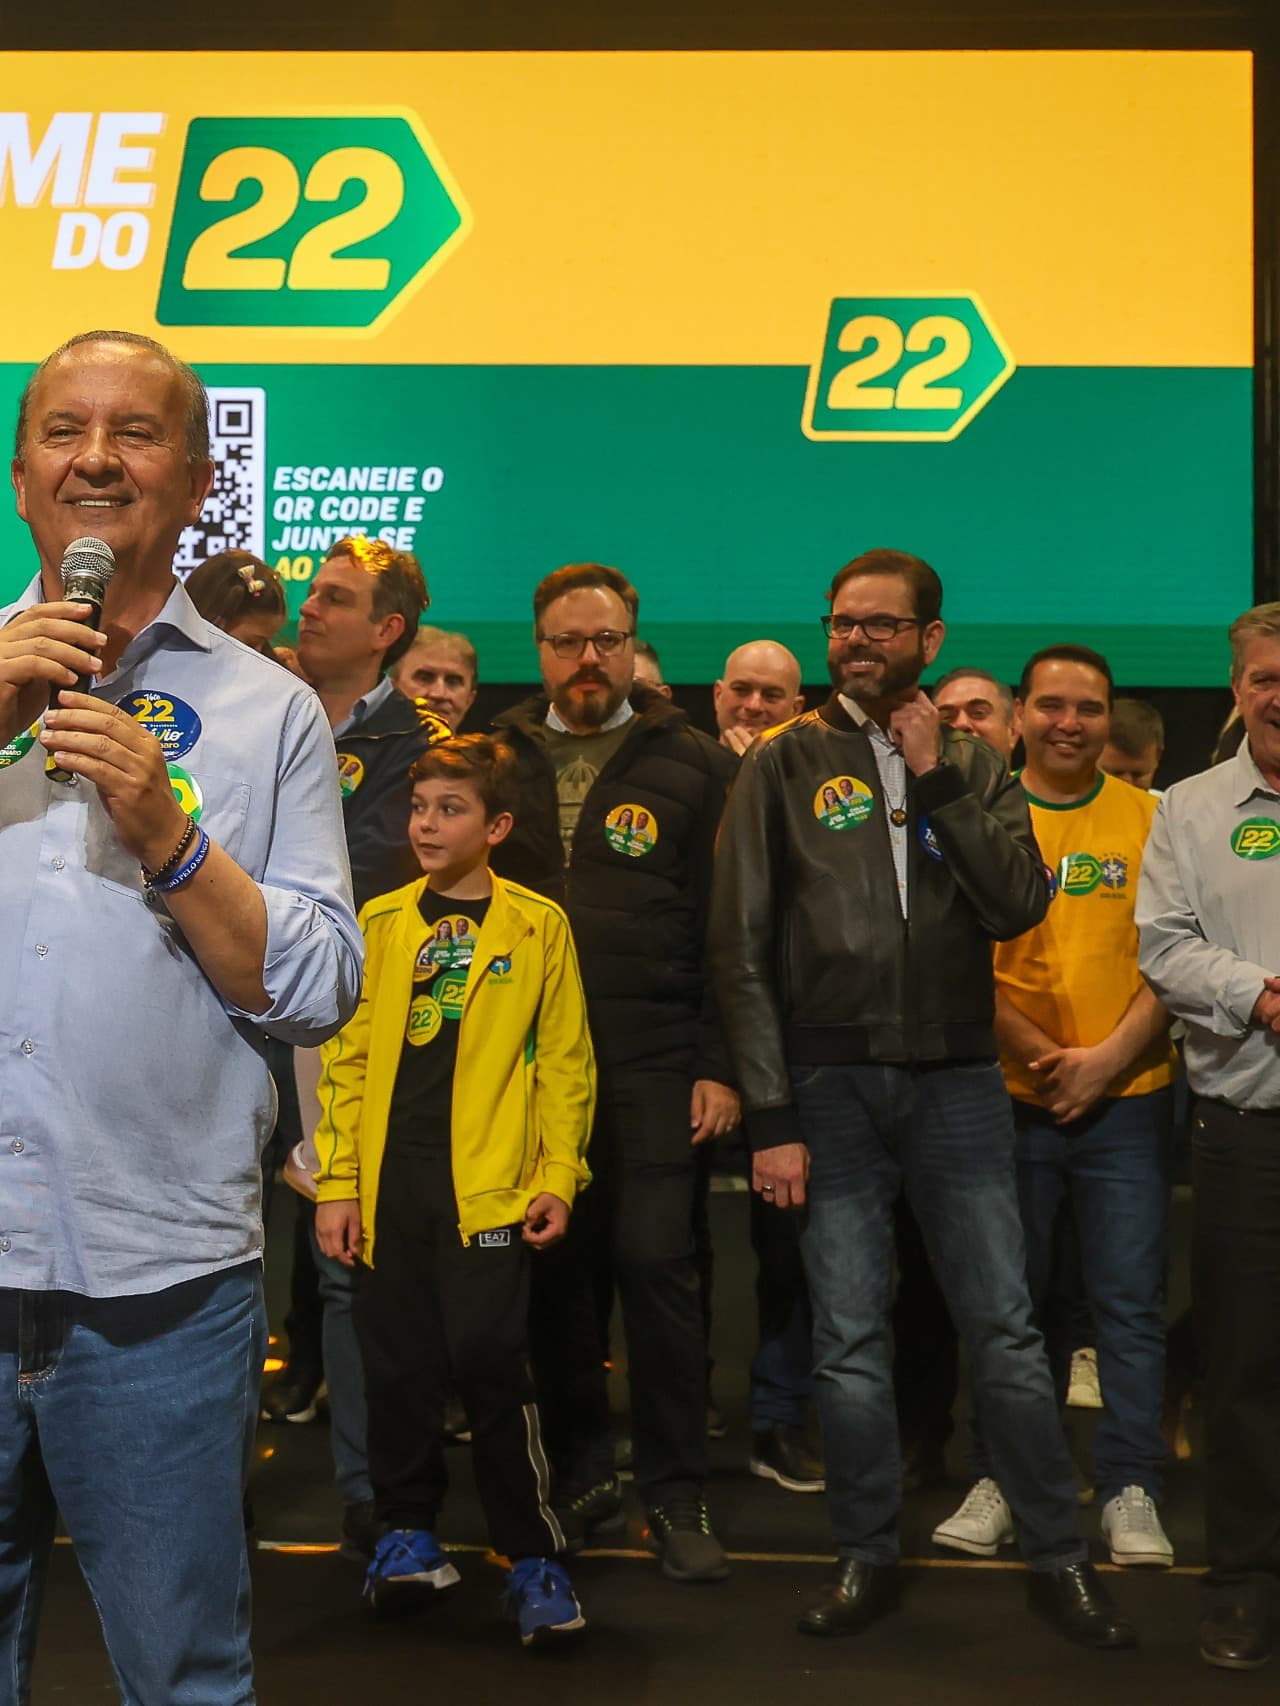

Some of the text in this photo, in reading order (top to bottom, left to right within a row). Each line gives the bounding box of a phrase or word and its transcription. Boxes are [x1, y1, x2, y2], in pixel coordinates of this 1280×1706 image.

[182, 146, 405, 291] 22
[51, 212, 150, 271] DO
[826, 315, 972, 410] 22
[273, 466, 444, 492] ESCANEIE O
[273, 496, 426, 523] QR CODE E
[275, 556, 314, 581] AO
[132, 698, 175, 722] 22
[1241, 829, 1275, 848] 22
[1067, 864, 1094, 884] 22
[410, 1008, 433, 1031] 22
[484, 1233, 506, 1241] EA7
